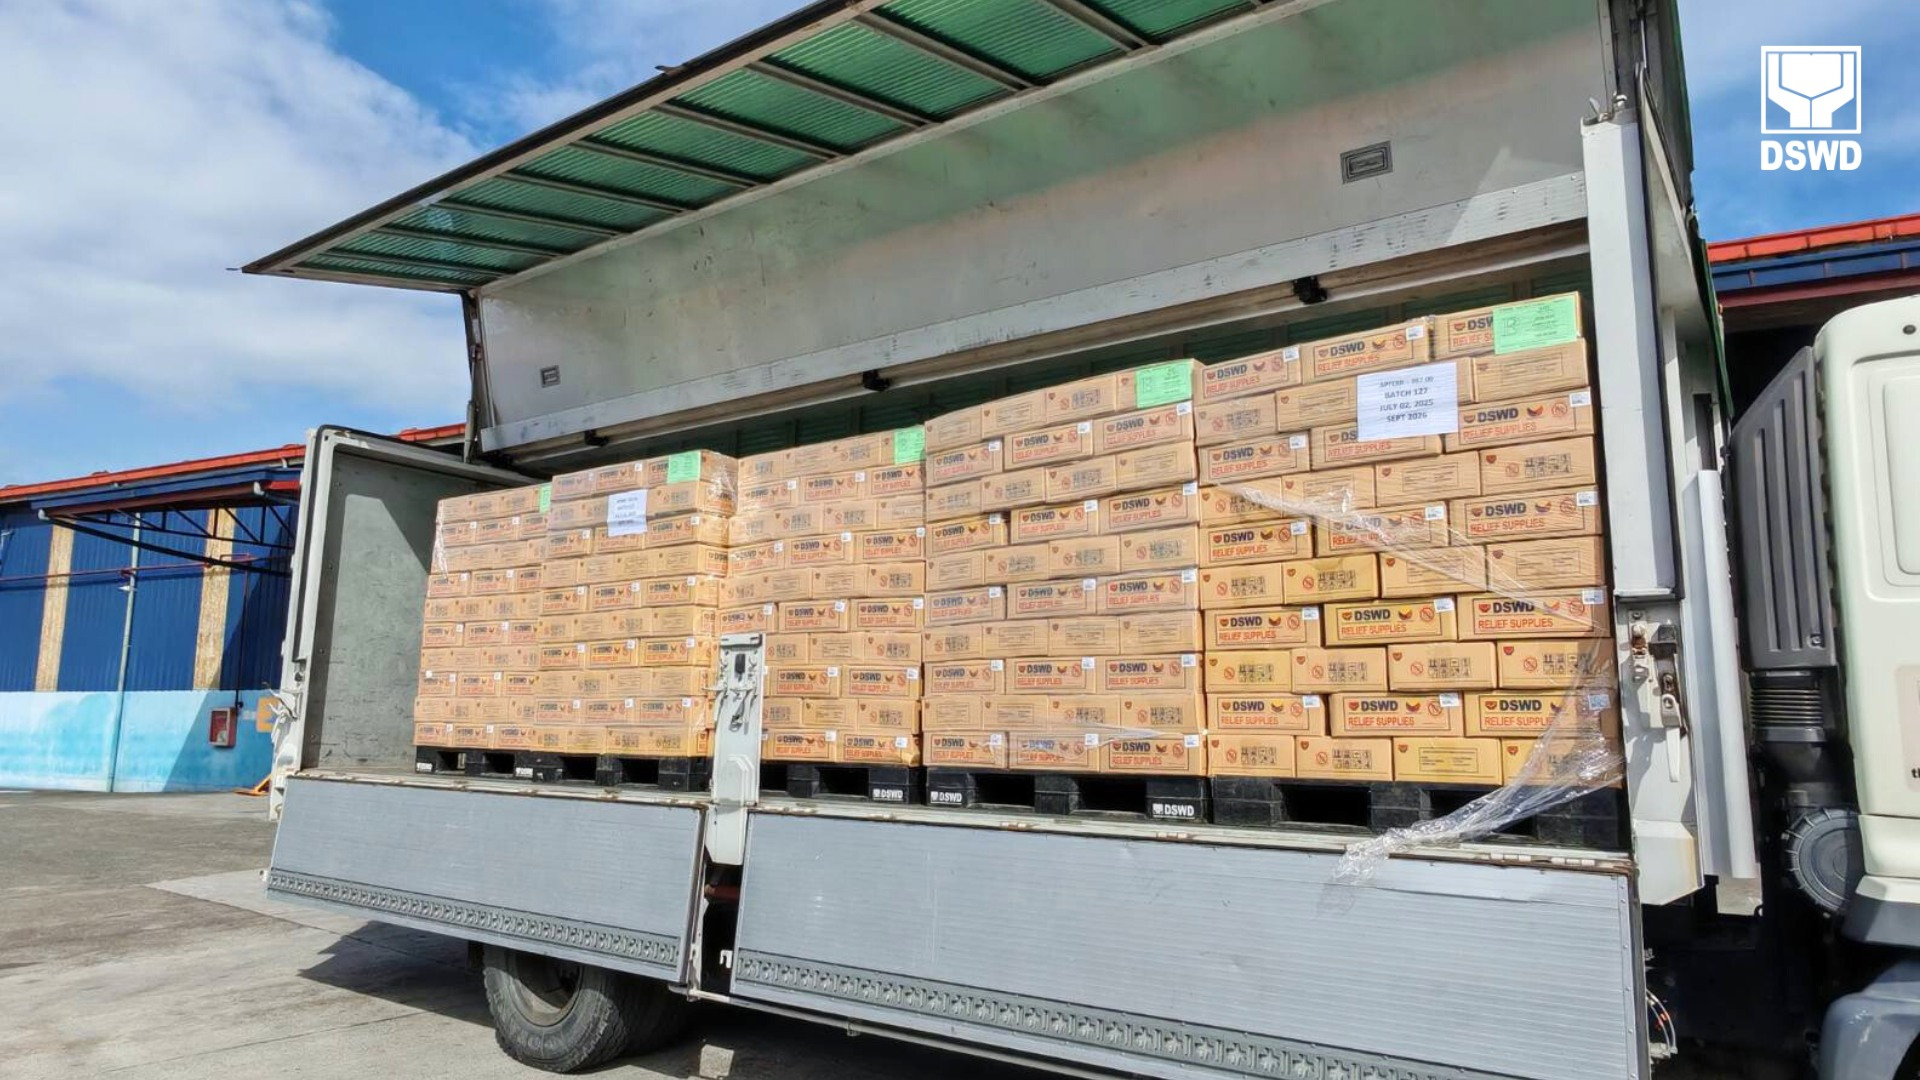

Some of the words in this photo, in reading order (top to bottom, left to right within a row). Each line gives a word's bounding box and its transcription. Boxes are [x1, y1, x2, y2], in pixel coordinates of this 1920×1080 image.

[1467, 316, 1493, 331] DSW
[1453, 334, 1481, 347] RELIEF
[1330, 340, 1366, 357] DSWD
[1217, 364, 1248, 380] DSWD
[1384, 389, 1412, 399] BATCH
[1380, 403, 1398, 412] JULY
[1386, 413, 1406, 423] SEPT
[1477, 407, 1519, 423] DSWD
[1116, 418, 1145, 431] DSWD
[1341, 430, 1357, 442] DS
[1463, 427, 1494, 441] RELIEF
[1495, 422, 1537, 436] SUPPLIES
[1223, 446, 1255, 461] DSWD
[1327, 444, 1355, 457] RELIEF
[1356, 440, 1392, 455] SUPPLIES
[1235, 459, 1268, 474] SUPPLIES
[1122, 498, 1150, 510] DSWD
[1485, 502, 1527, 517] DSWD
[1030, 510, 1056, 523] DSWD
[1470, 522, 1499, 534] RELIEF
[1501, 518, 1545, 531] SUPPLIES
[1223, 530, 1255, 543] DSWD
[1212, 546, 1236, 558] RELIEF
[1236, 544, 1269, 557] SUPPLIES
[1119, 581, 1148, 592] DSWD
[1493, 600, 1536, 613] DSWD
[1354, 608, 1391, 621] DSWD
[1230, 616, 1263, 628] DSWD
[1478, 618, 1509, 629] RELIEF
[1509, 617, 1554, 629] SUPPLIES
[1219, 631, 1243, 641] RELIEF
[1243, 629, 1277, 641] SUPPLIES
[1341, 624, 1368, 636] RELIEF
[1370, 622, 1407, 634] SUPPLIES
[1026, 664, 1053, 674] DSWD
[1119, 662, 1148, 673] DSWD
[1232, 700, 1265, 712] DSWD
[1361, 699, 1399, 712] DSWD
[1499, 699, 1542, 711] DSWD
[1221, 716, 1245, 726] RELIEF
[1245, 715, 1279, 726] SUPPLIES
[1348, 716, 1376, 727] RELIEF
[1376, 716, 1415, 727] SUPPLIES
[1485, 716, 1515, 726] RELIEF
[1122, 741, 1151, 752] DSWD
[939, 791, 962, 803] DSWD
[1164, 804, 1195, 817] DSWD
